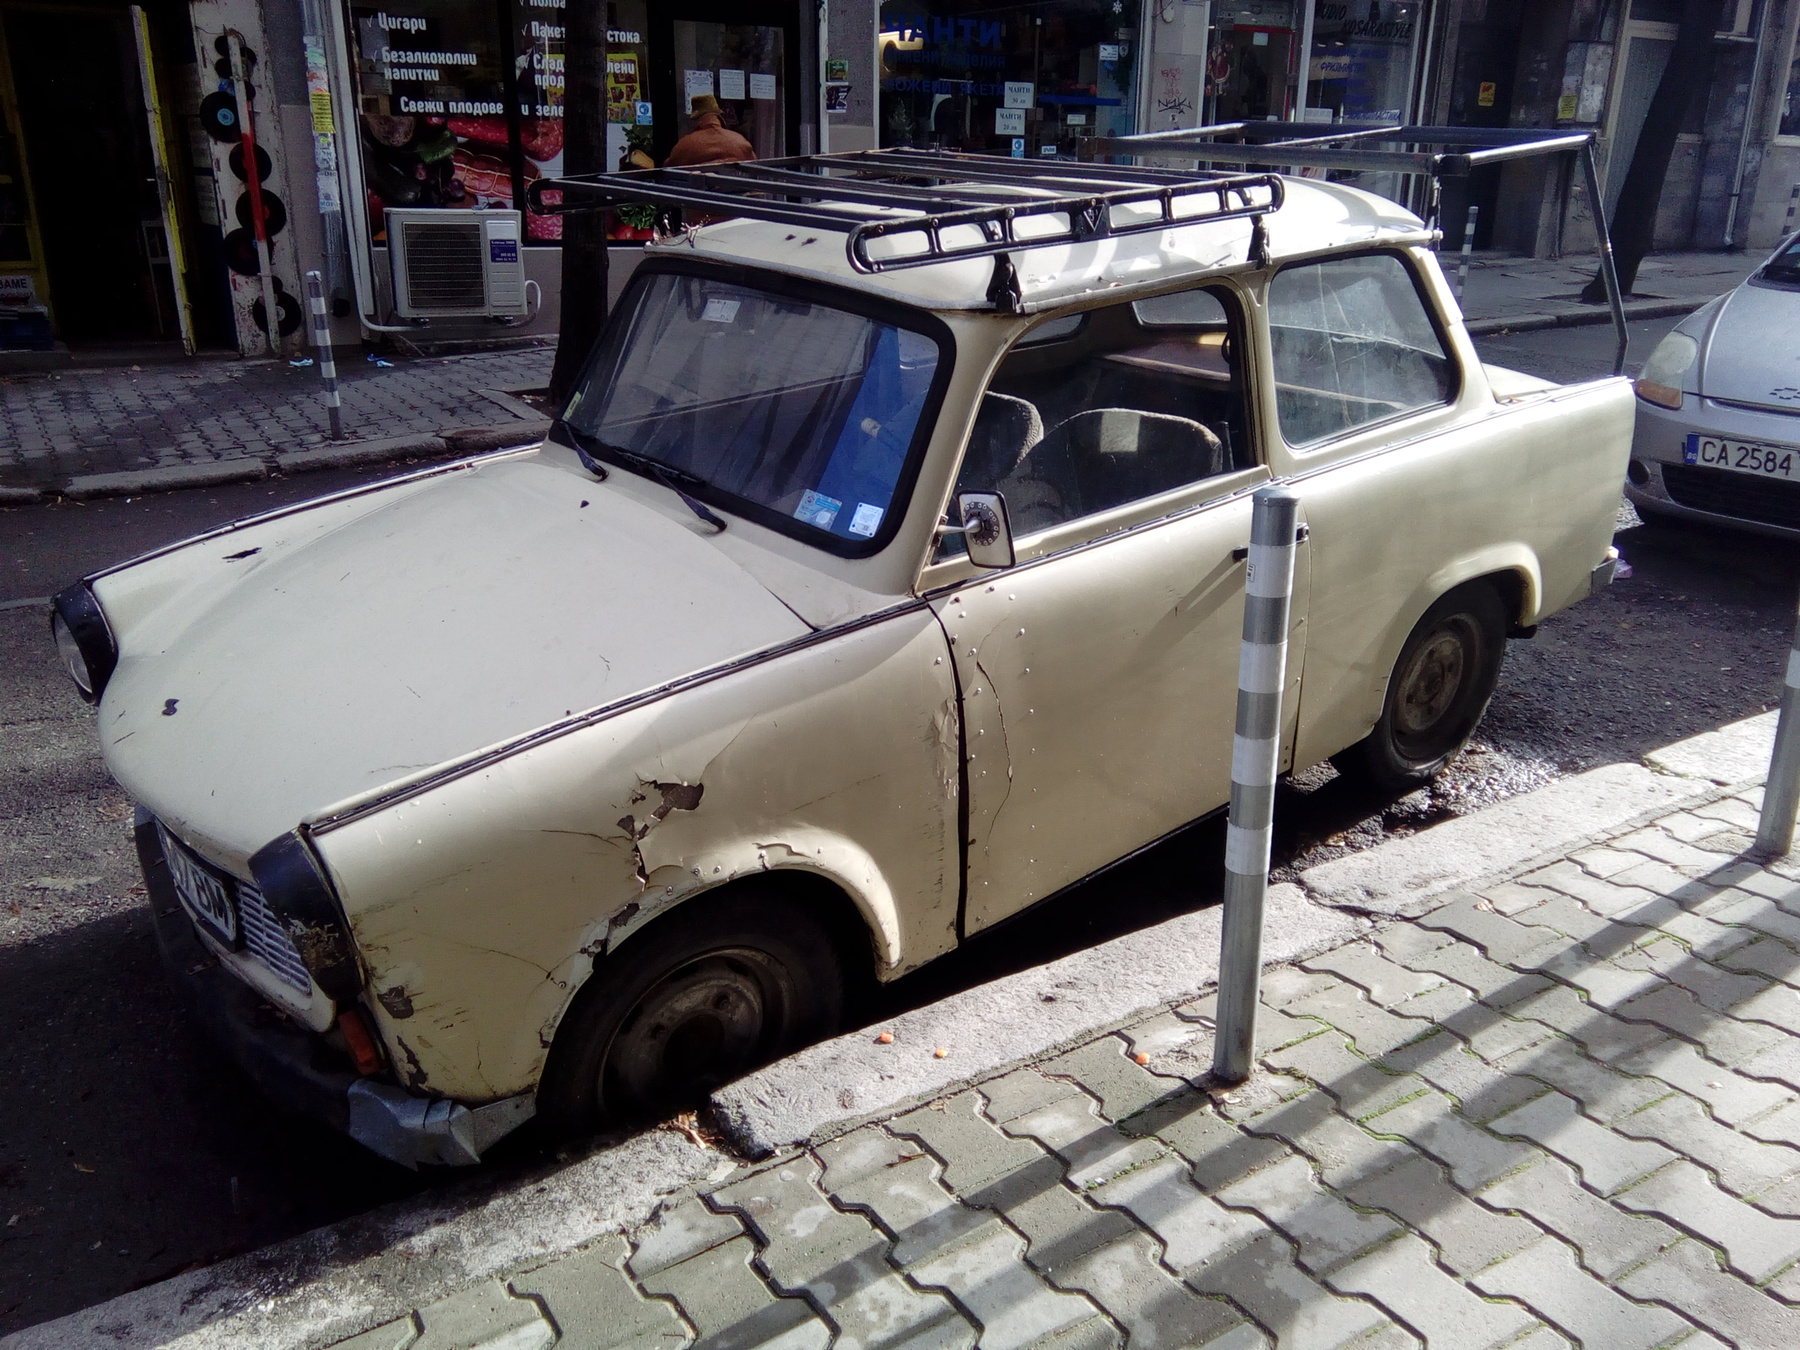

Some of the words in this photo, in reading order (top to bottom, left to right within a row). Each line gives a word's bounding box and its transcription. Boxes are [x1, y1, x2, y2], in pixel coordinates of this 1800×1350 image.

[378, 12, 427, 34] Цигари
[531, 21, 566, 38] Пакет
[885, 13, 1002, 48] ЧАНТИ
[382, 47, 477, 66] Безалкохолни
[533, 53, 565, 73] Слад
[384, 68, 439, 81] напитки
[534, 75, 565, 90] прод
[400, 96, 444, 114] Свежи
[449, 101, 504, 116] плодове
[521, 104, 529, 116] и
[535, 104, 564, 118] зеле
[1702, 441, 1729, 466] CA
[1735, 446, 1793, 476] 2584
